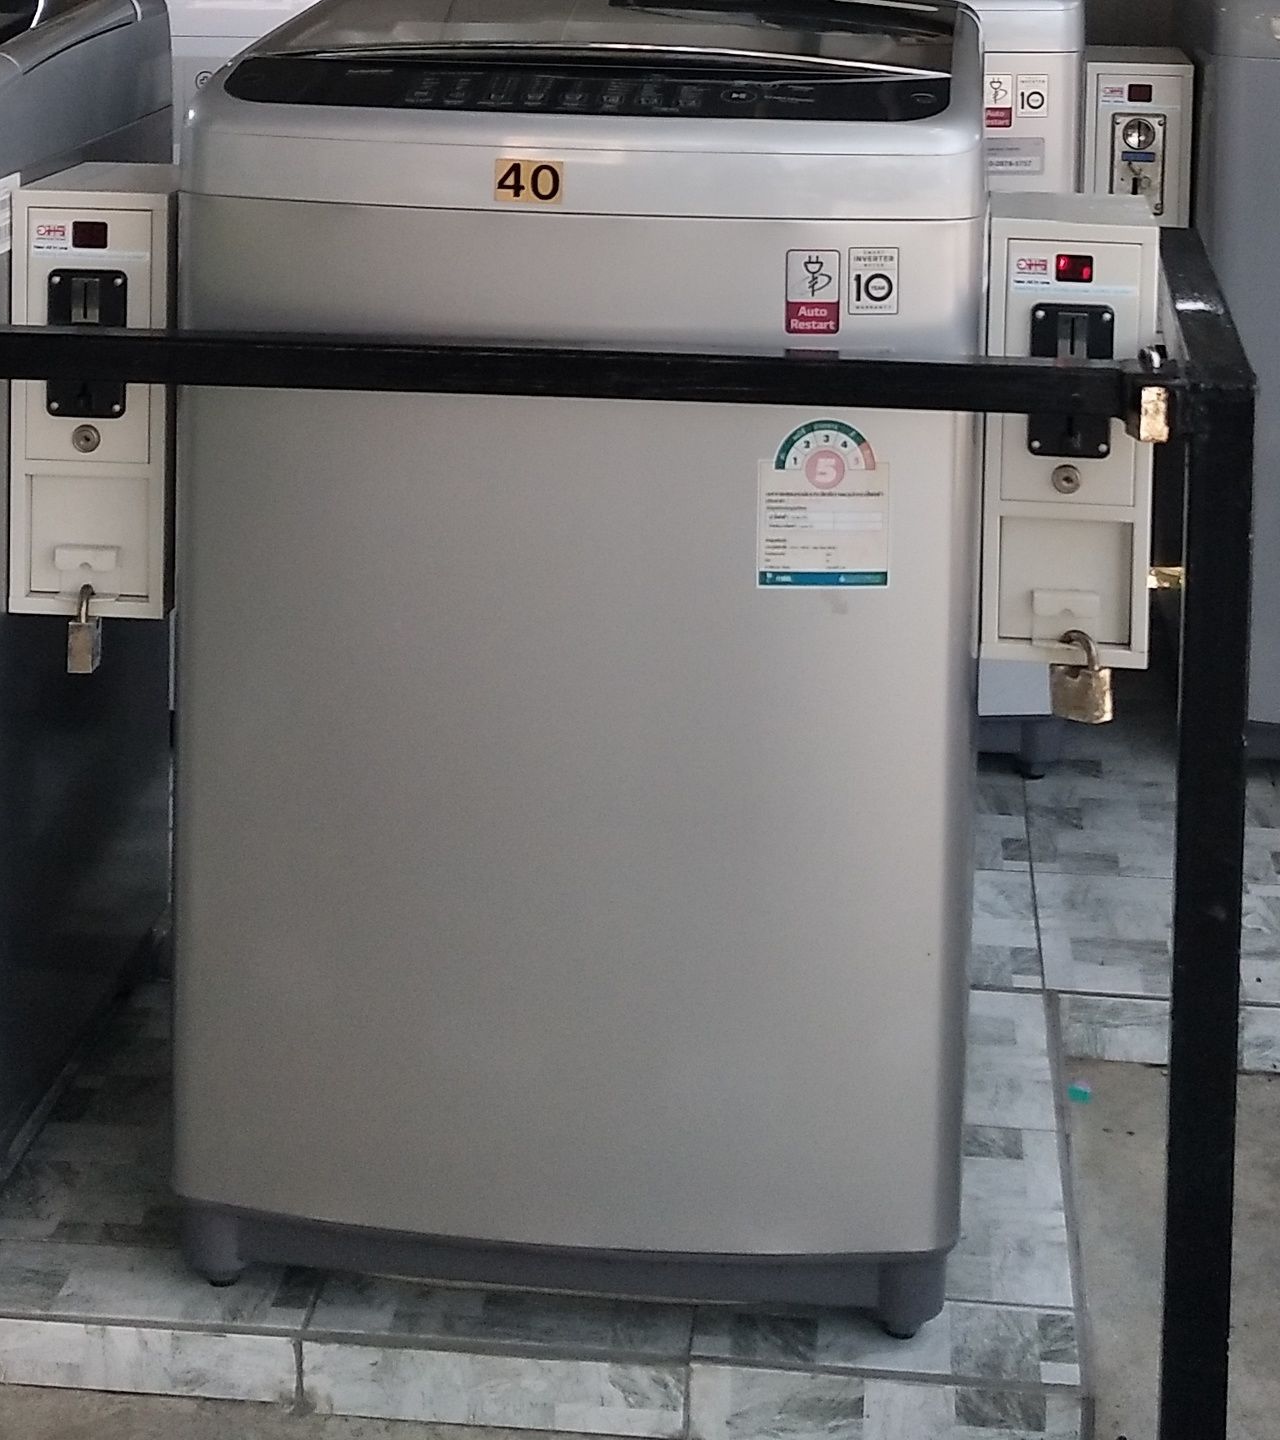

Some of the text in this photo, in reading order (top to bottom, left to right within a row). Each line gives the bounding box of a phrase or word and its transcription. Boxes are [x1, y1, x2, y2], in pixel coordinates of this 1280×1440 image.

[1021, 90, 1045, 110] 10
[986, 109, 1005, 118] Auto
[496, 162, 561, 201] 40
[853, 273, 893, 302] 10
[797, 305, 828, 317] Auto
[790, 318, 836, 330] Restart
[803, 440, 810, 449] 2
[823, 434, 830, 443] 3
[840, 440, 848, 449] 4
[792, 456, 798, 466] 1
[815, 458, 837, 484] 5
